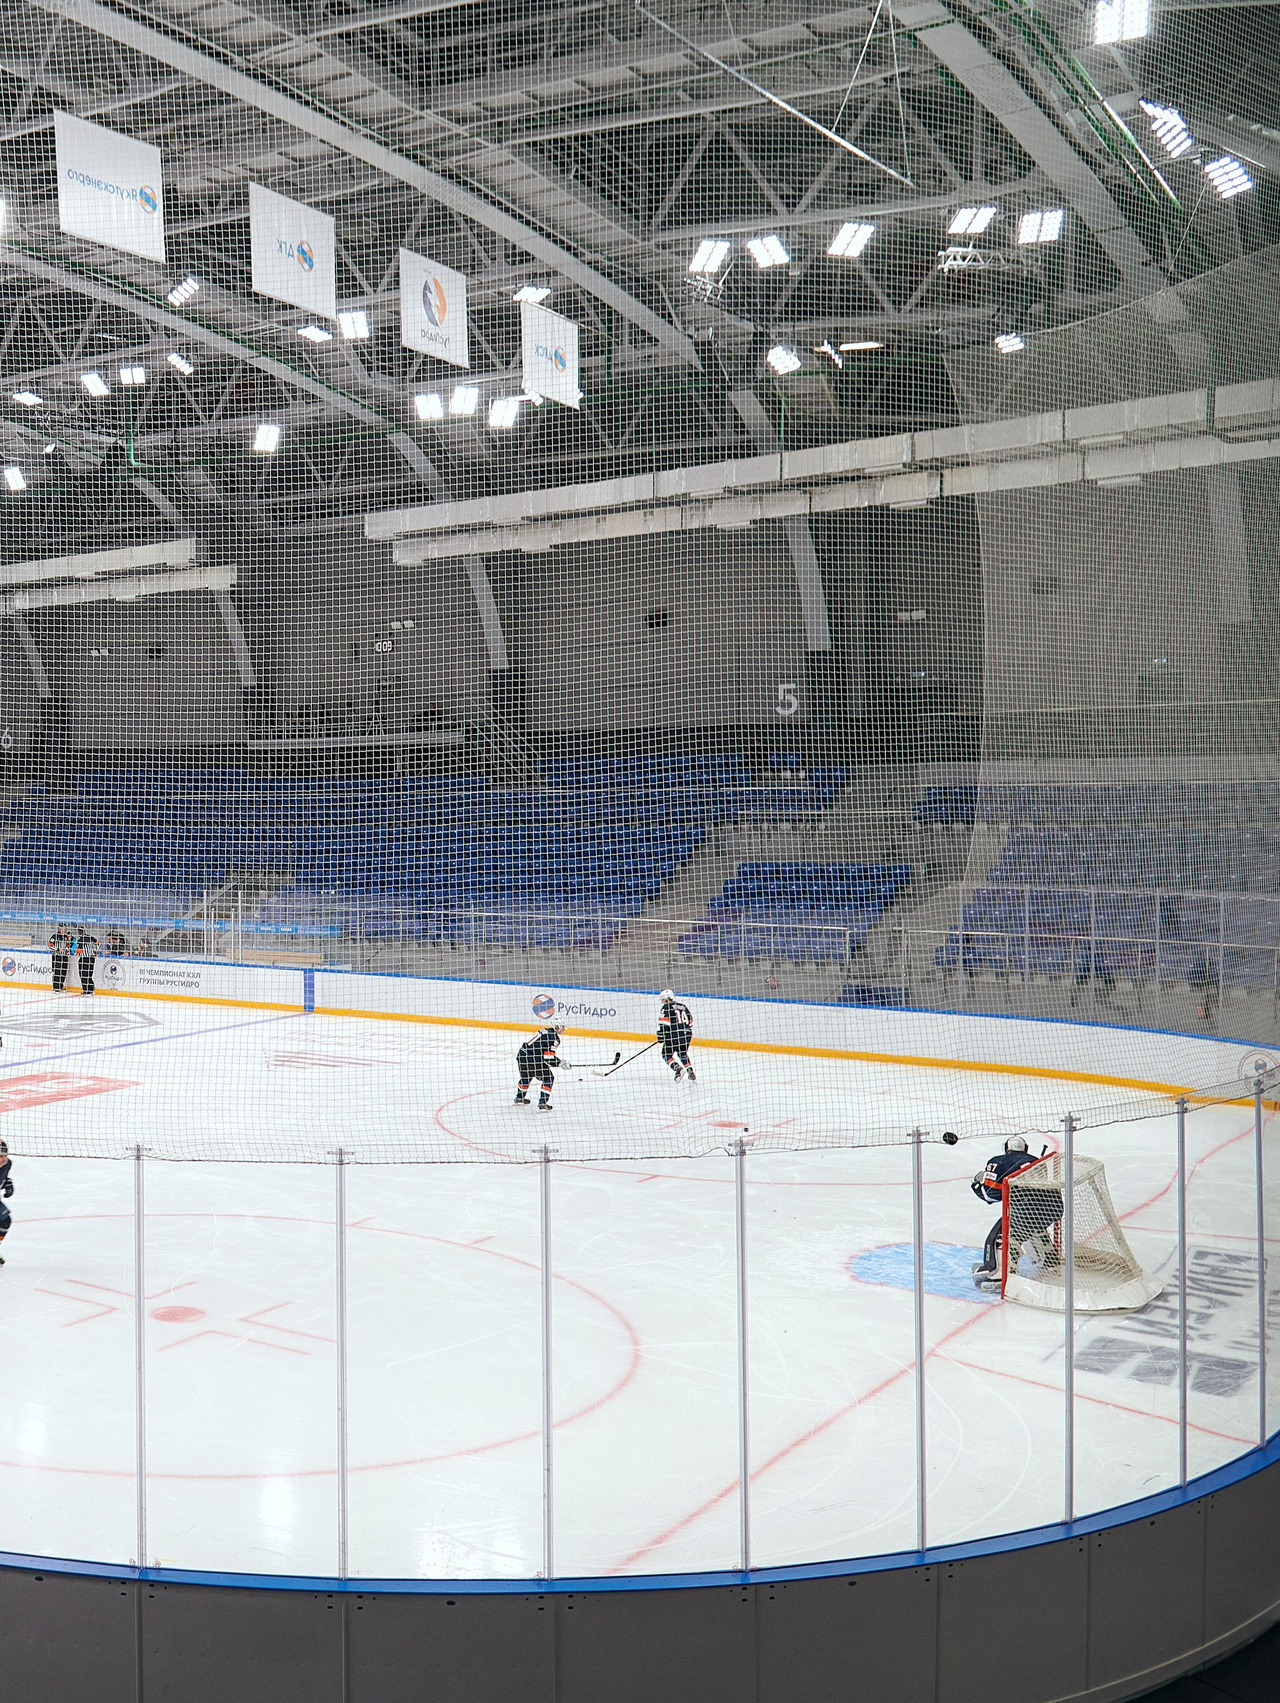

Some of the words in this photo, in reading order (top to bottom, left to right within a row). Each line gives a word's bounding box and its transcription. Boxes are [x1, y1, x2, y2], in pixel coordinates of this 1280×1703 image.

[775, 683, 798, 717] 5
[17, 962, 53, 975] РусГидро
[146, 969, 186, 978] ЧЕМПИОНАТ
[186, 972, 201, 980] КХЛ
[139, 977, 165, 986] ГРУППЫ
[165, 979, 200, 988] РУСГИДРО
[557, 1002, 617, 1019] РусГидро
[674, 1010, 689, 1025] 14
